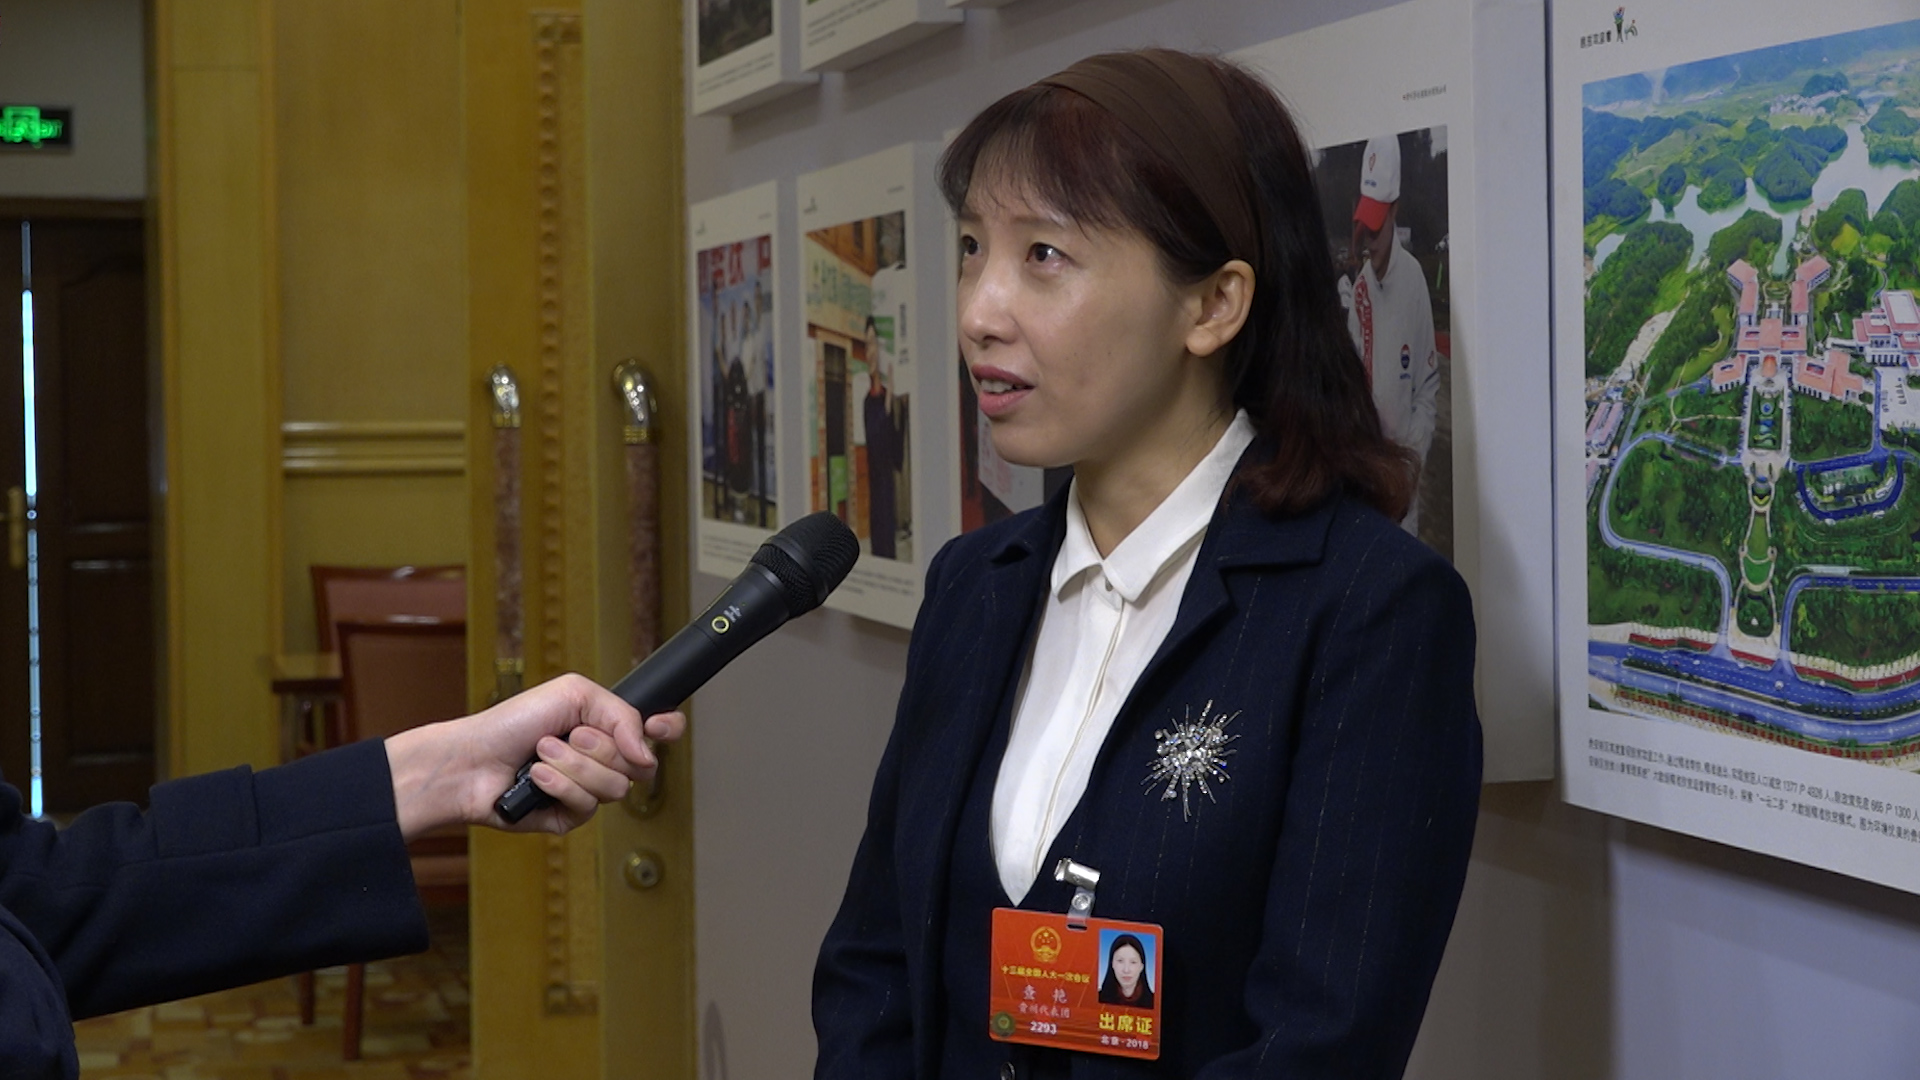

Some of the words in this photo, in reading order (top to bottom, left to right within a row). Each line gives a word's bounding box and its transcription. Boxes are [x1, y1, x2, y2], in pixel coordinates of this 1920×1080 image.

[1018, 1001, 1071, 1019] 贵州代表团
[1030, 1021, 1058, 1035] 2293
[1099, 1012, 1153, 1036] 出席证
